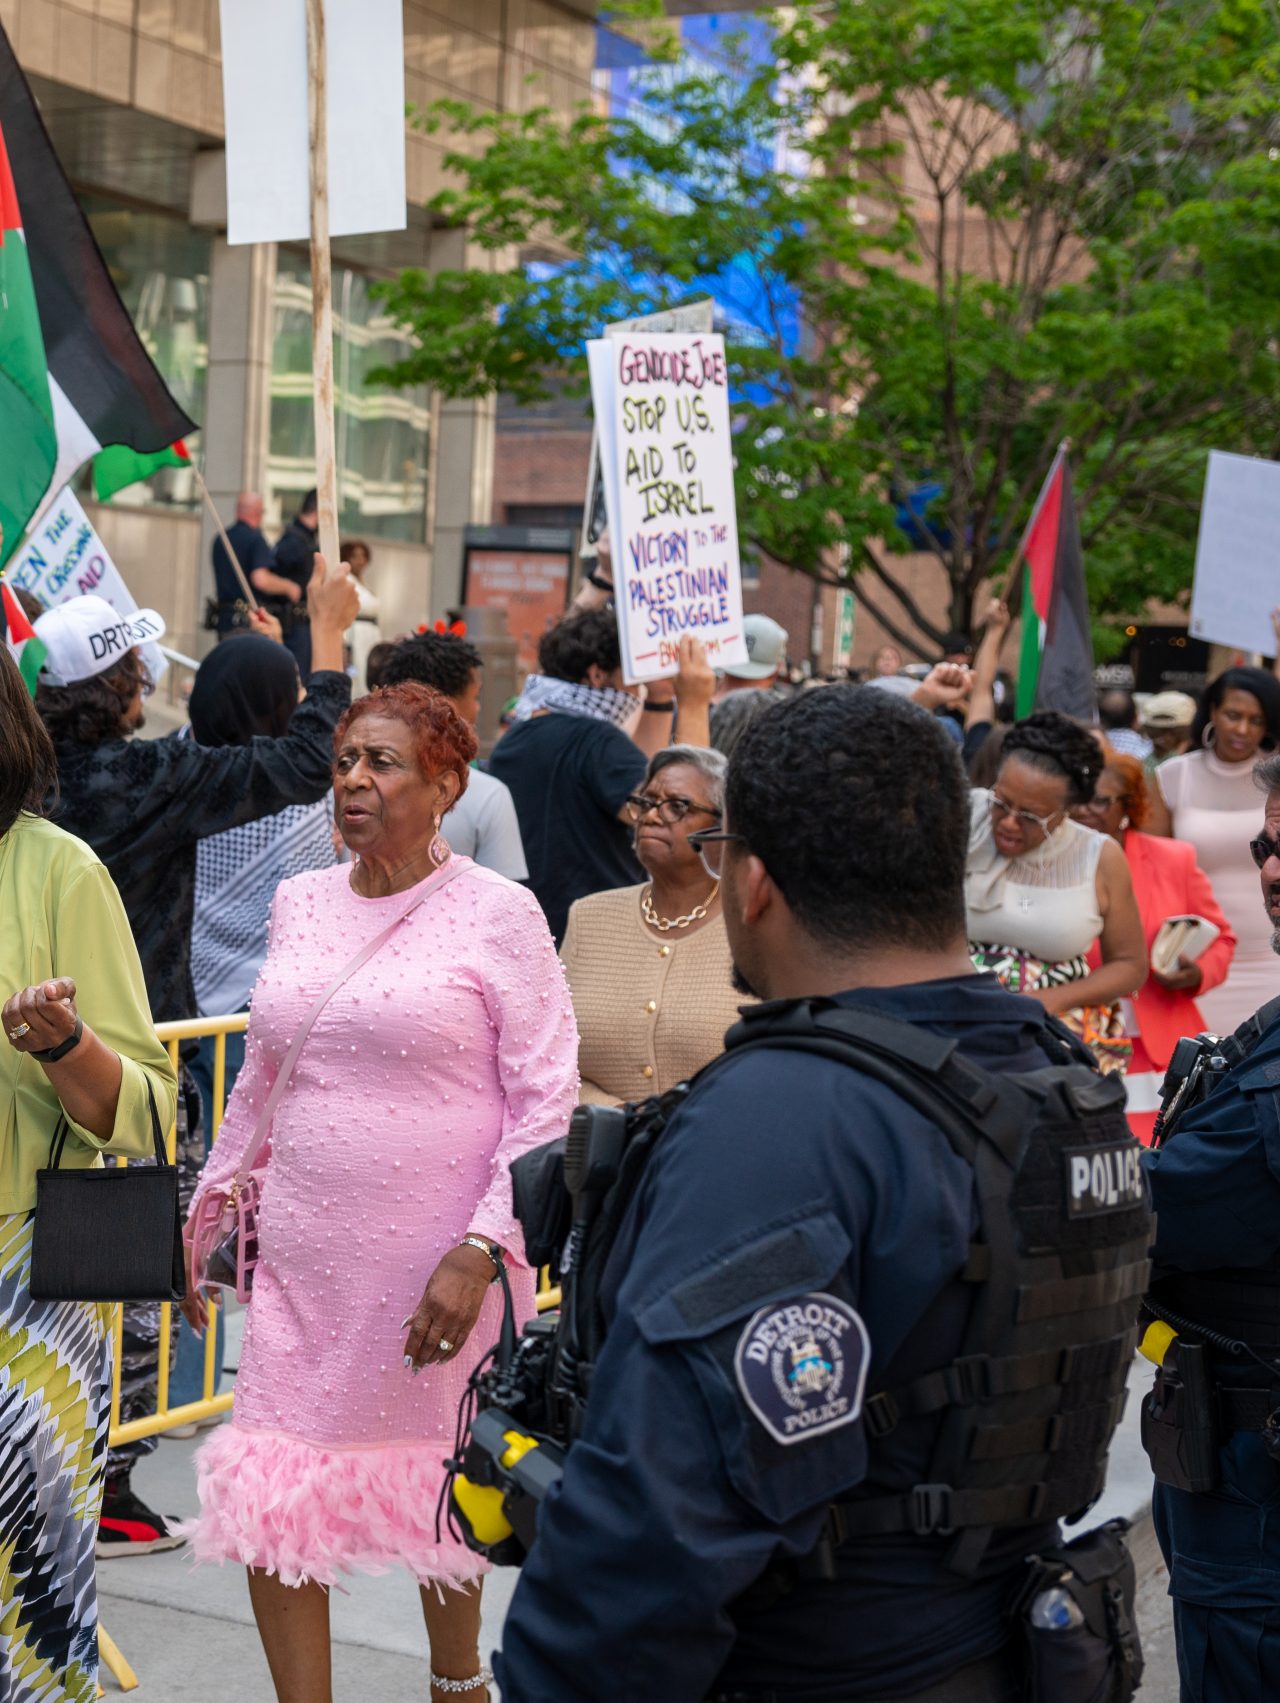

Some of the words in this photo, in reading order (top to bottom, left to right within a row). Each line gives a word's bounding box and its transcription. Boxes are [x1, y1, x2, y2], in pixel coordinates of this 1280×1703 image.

[623, 395, 666, 434] STOP
[676, 394, 714, 435] U.S.
[626, 445, 663, 486] AID
[673, 440, 696, 474] TO
[638, 480, 714, 523] ISRAEL
[44, 508, 74, 545] THE
[629, 528, 688, 573] VICTORY
[694, 529, 708, 547] TO
[710, 523, 728, 544] THE
[629, 562, 729, 612] PALESTINIAN
[646, 597, 729, 638] STRUGGLE
[1071, 1147, 1142, 1209] POLICE
[745, 1303, 850, 1366] DETROIT
[783, 1397, 849, 1433] POLICE
